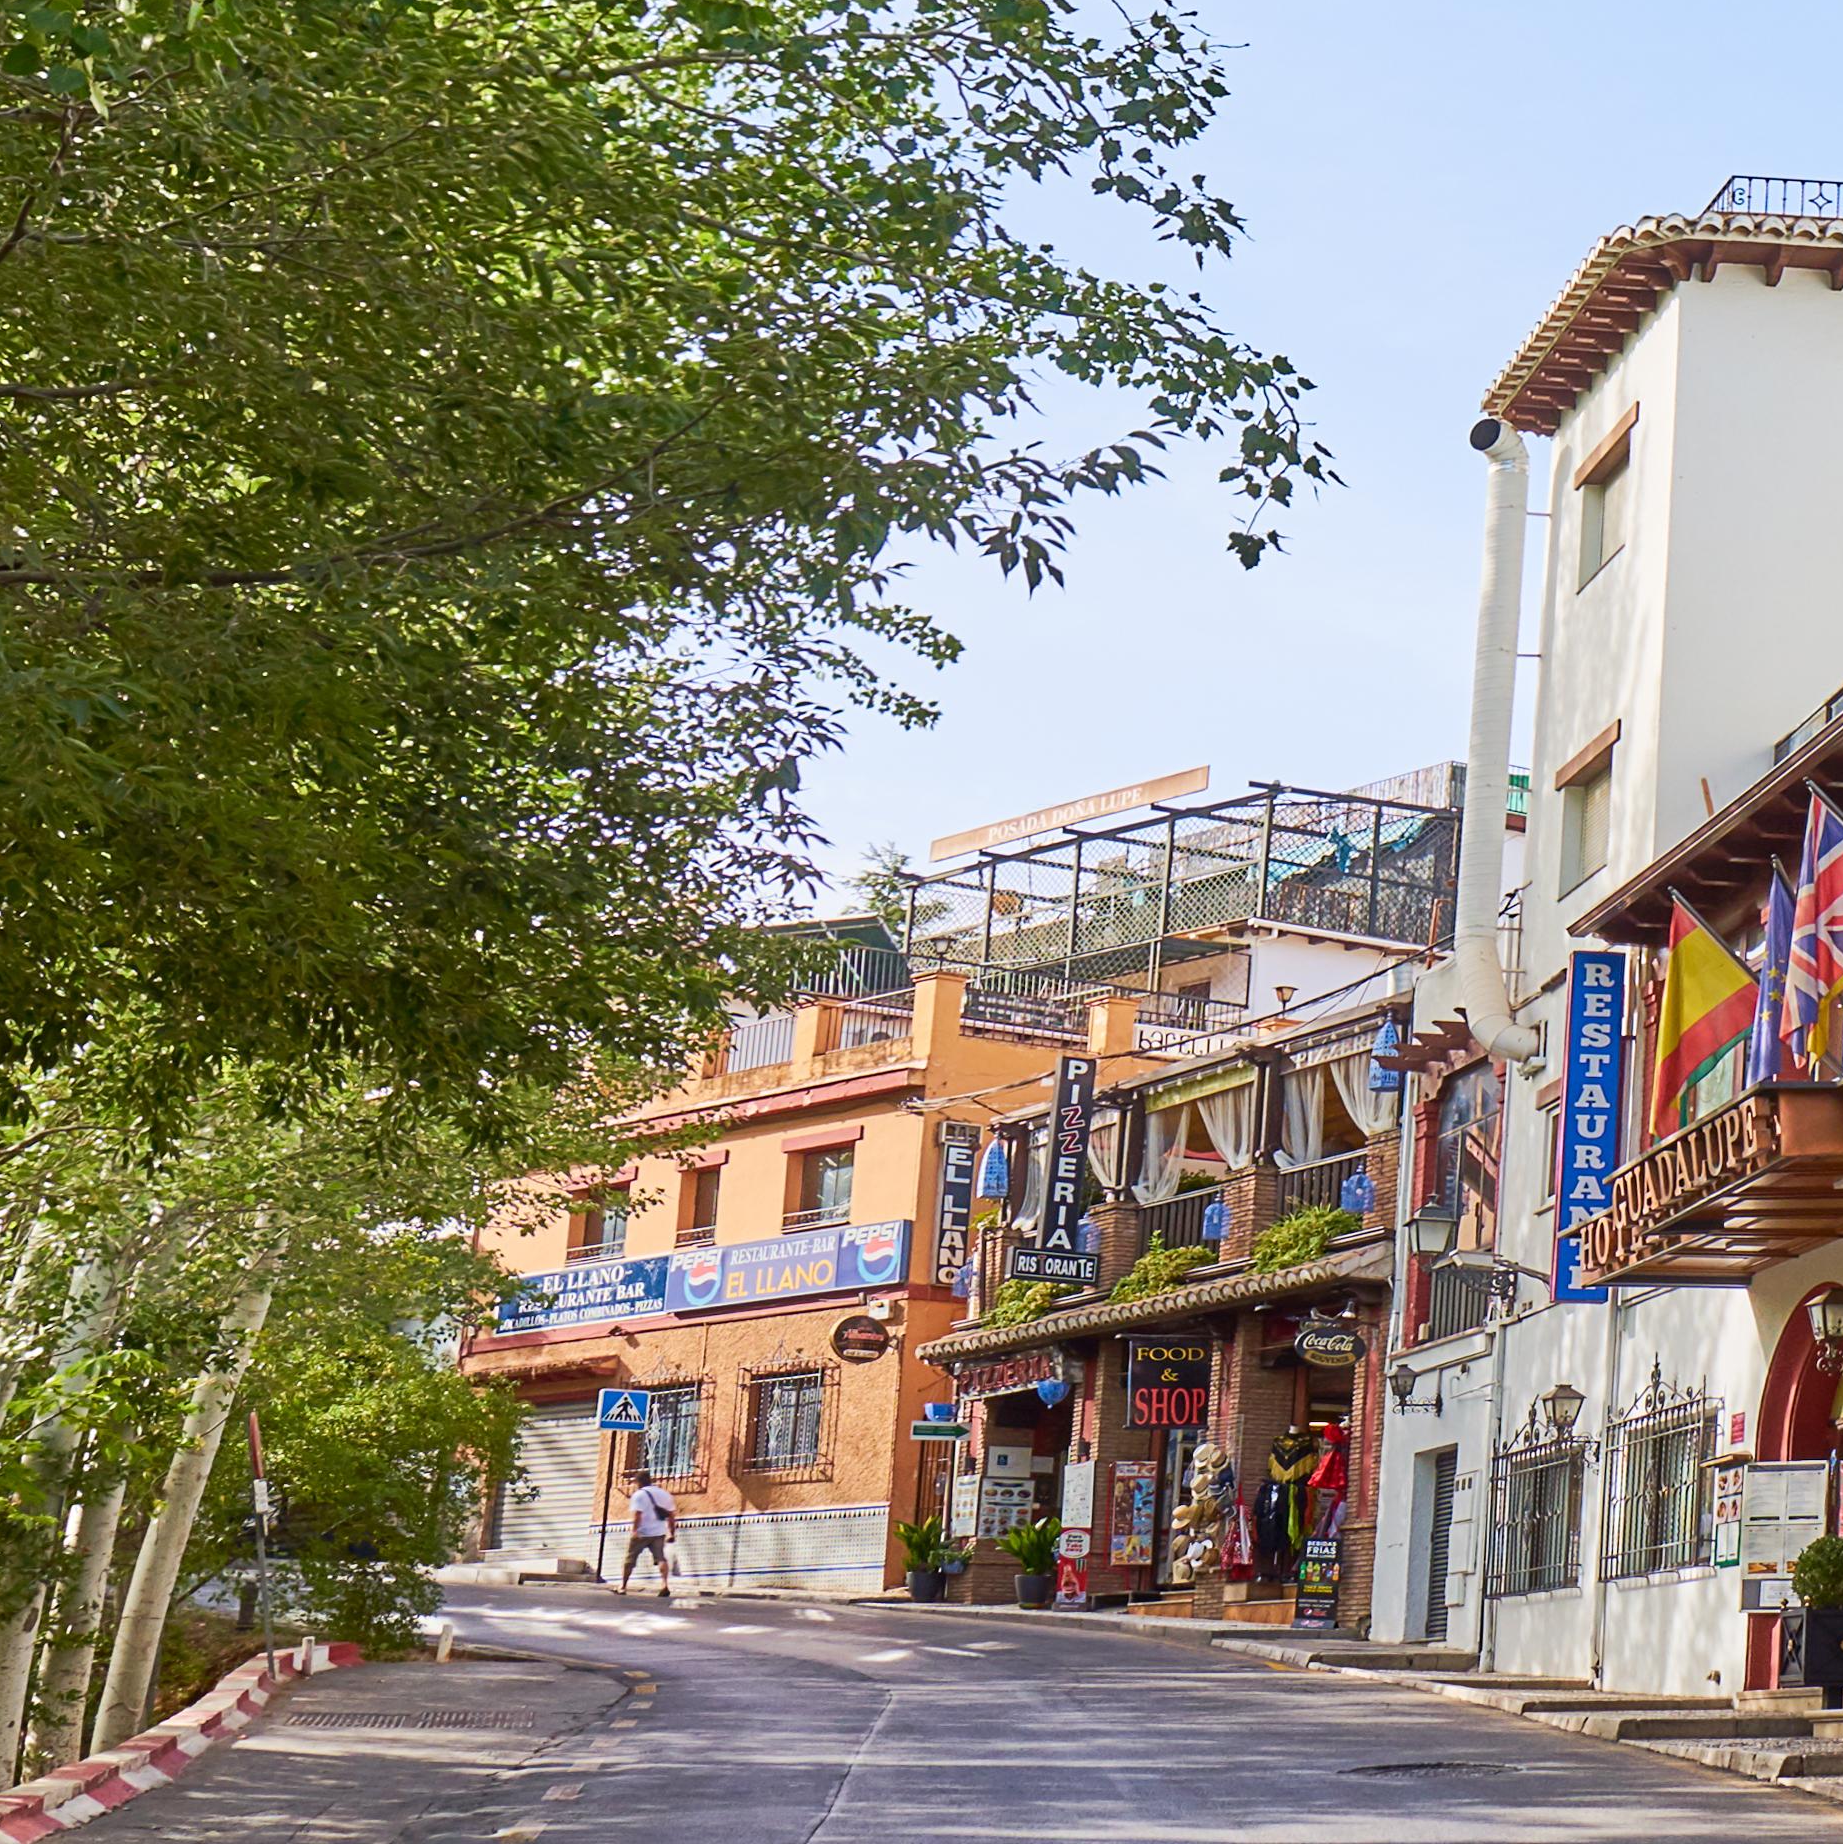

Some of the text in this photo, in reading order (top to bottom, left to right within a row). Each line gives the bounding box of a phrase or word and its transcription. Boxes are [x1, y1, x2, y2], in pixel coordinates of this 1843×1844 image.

[987, 787, 1143, 844] POSADA DOÑA LUPE
[946, 1147, 973, 1184] EL
[1046, 1059, 1089, 1250] PIZZERIA
[1611, 1098, 1757, 1227] GUADALUPE
[730, 1235, 837, 1266] RESTAURANTE-BAR
[841, 1222, 900, 1248] PEPSI
[937, 1194, 969, 1285] LLANO
[670, 1248, 723, 1273] PEPSI
[726, 1259, 834, 1299] EL LLANO
[1017, 1255, 1095, 1283] RISTORANTE
[615, 1282, 645, 1300] BAR
[1136, 1347, 1205, 1362] FOOD
[960, 1355, 1052, 1394] PIZZERIA
[1160, 1368, 1179, 1382] &
[1134, 1387, 1206, 1426] SHOP
